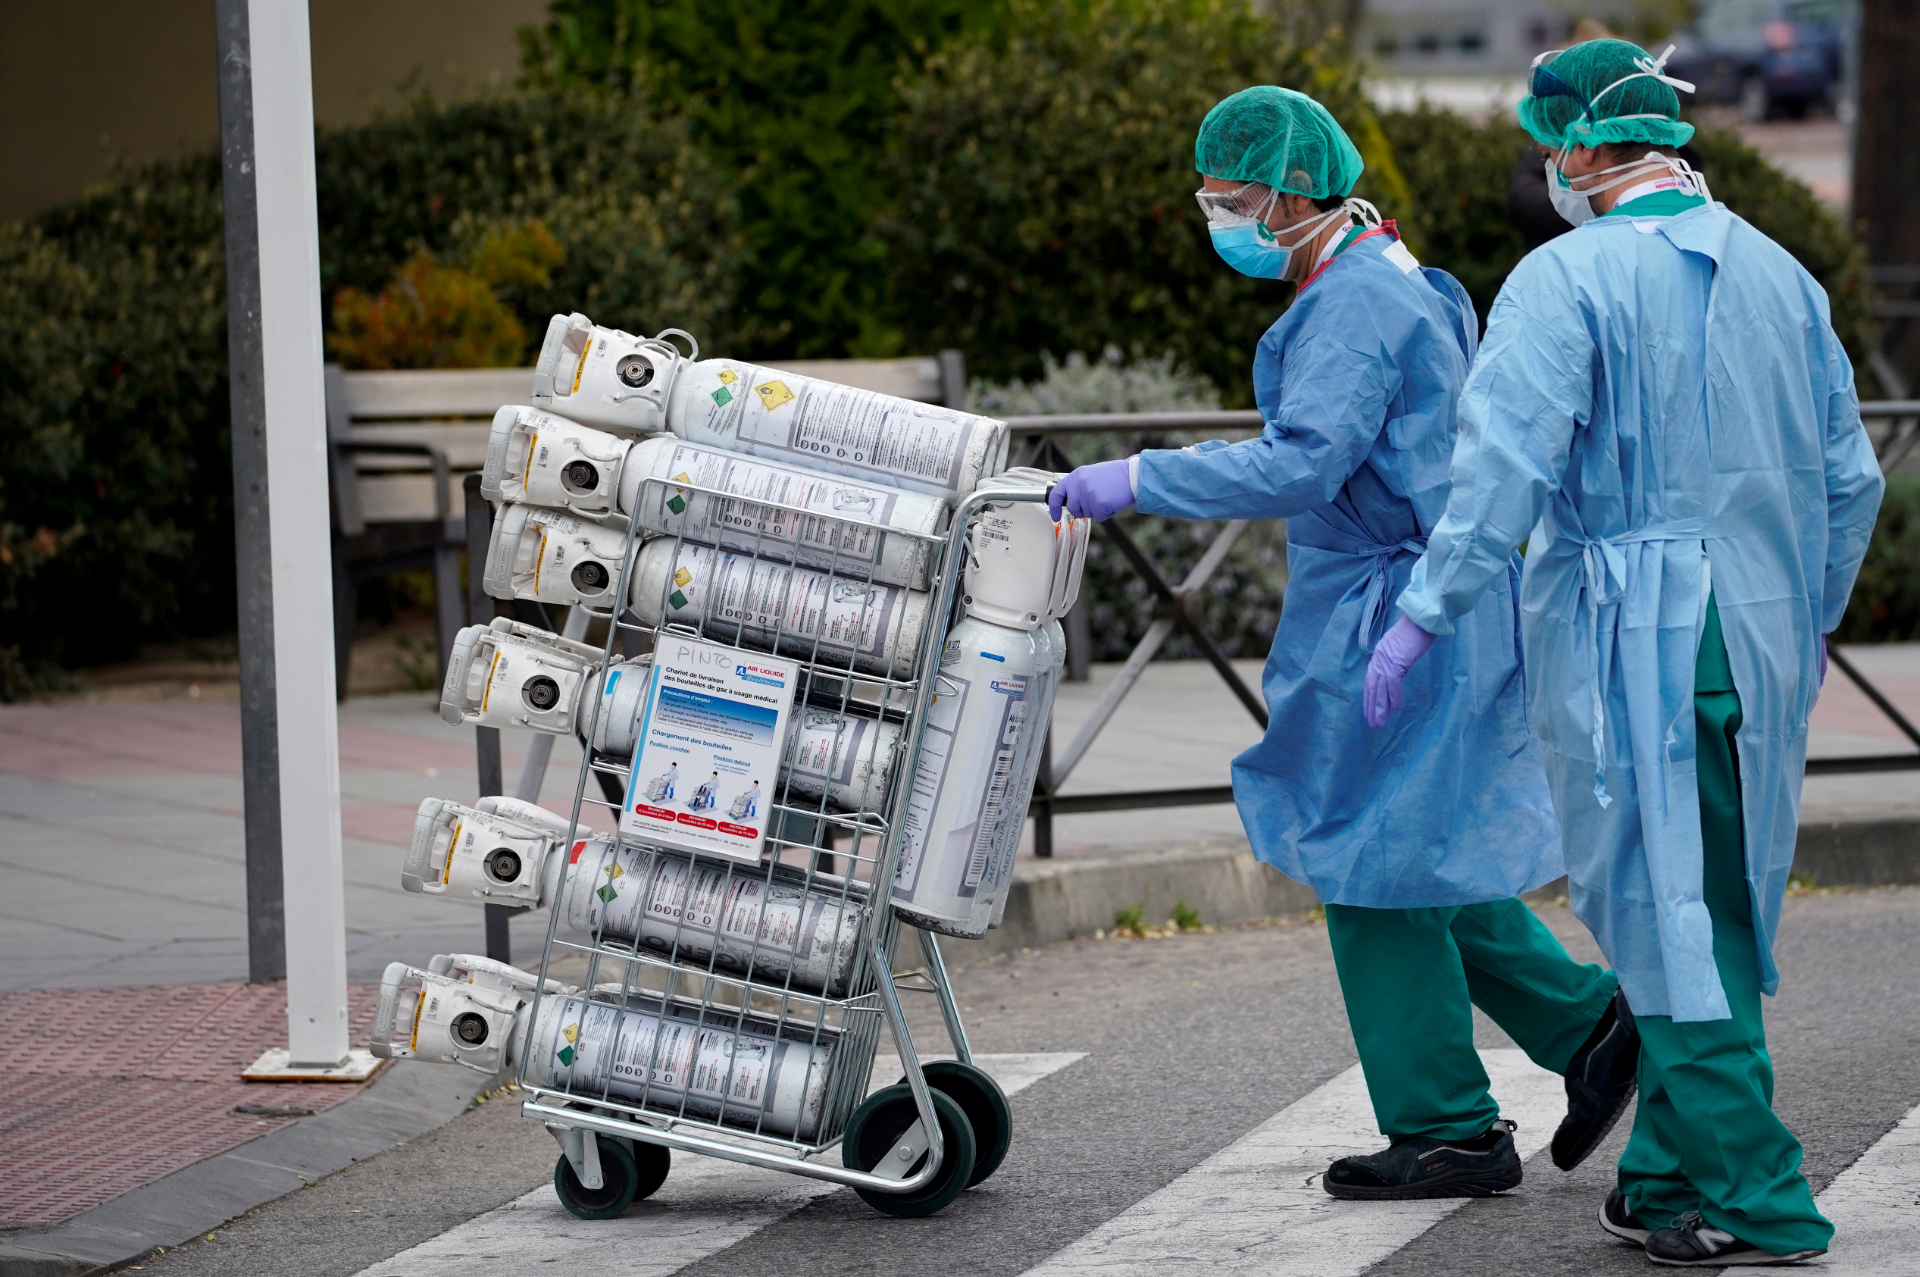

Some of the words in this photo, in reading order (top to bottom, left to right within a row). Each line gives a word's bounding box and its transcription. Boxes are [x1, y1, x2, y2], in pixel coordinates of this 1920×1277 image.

[813, 555, 872, 573] MEDICNAL
[676, 644, 733, 670] PINTO
[813, 651, 873, 666] MEDICINA
[665, 666, 688, 676] Chariot
[698, 674, 724, 684] livraison
[746, 664, 758, 673] AIR
[759, 666, 785, 678] LIQUIDE
[676, 677, 706, 688] bouteilles
[733, 690, 752, 699] usage
[753, 693, 778, 704] médical
[651, 728, 689, 742] Chargement
[702, 739, 732, 751] bouteilles
